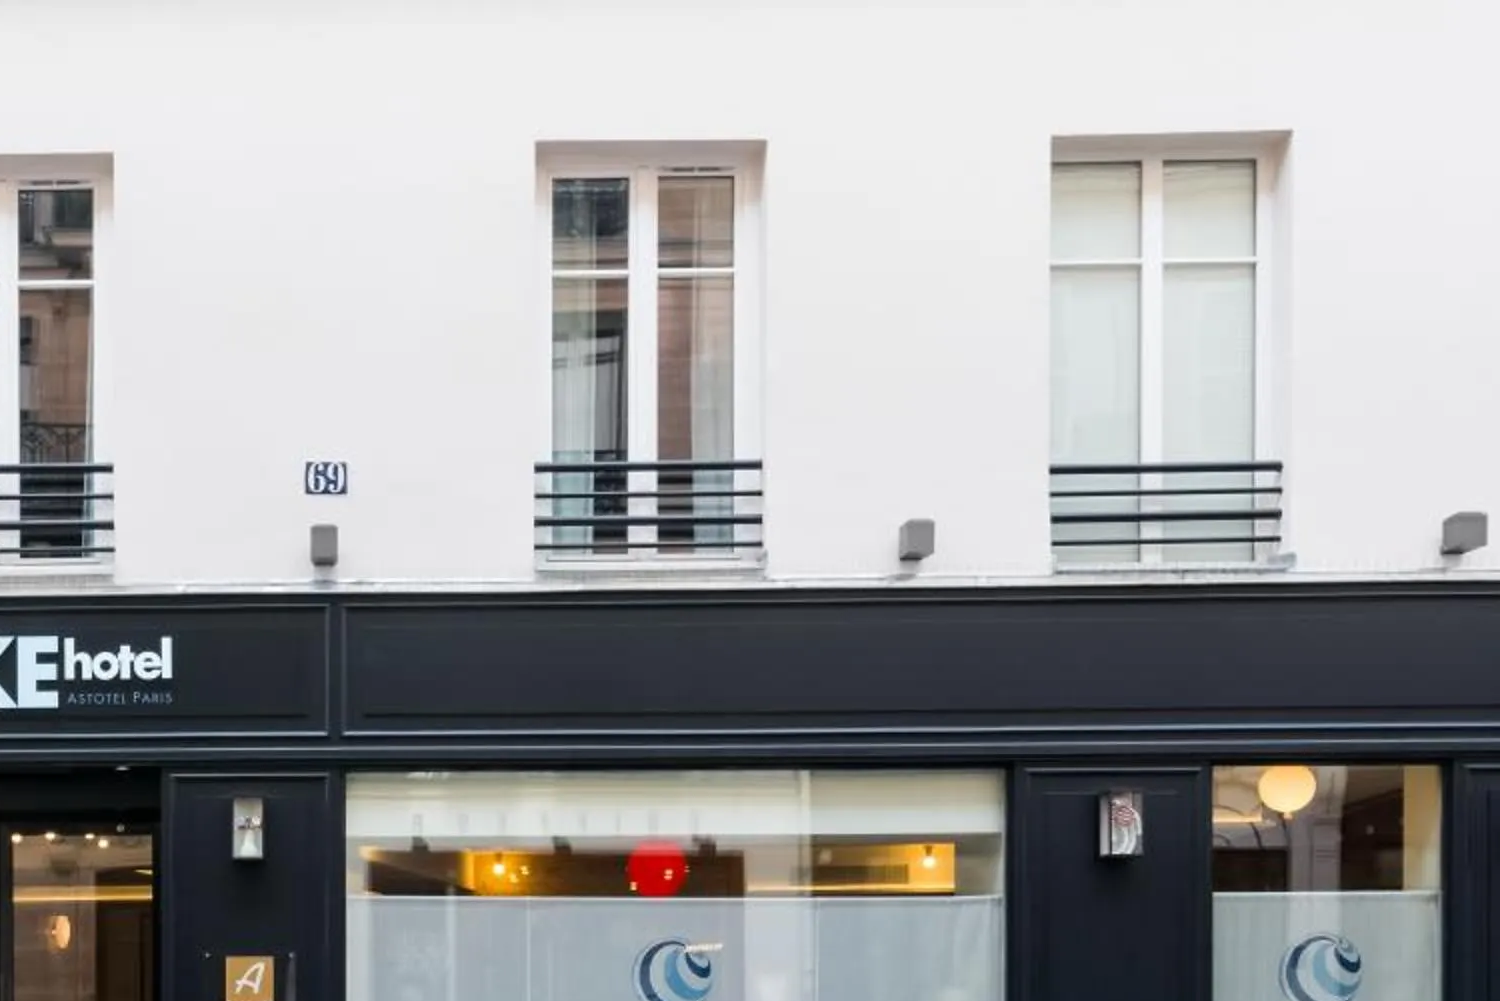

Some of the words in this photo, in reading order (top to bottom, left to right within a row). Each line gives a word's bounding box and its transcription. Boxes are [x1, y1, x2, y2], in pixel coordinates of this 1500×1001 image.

[307, 461, 345, 493] 69
[63, 636, 173, 681] hotel
[234, 961, 266, 995] A
